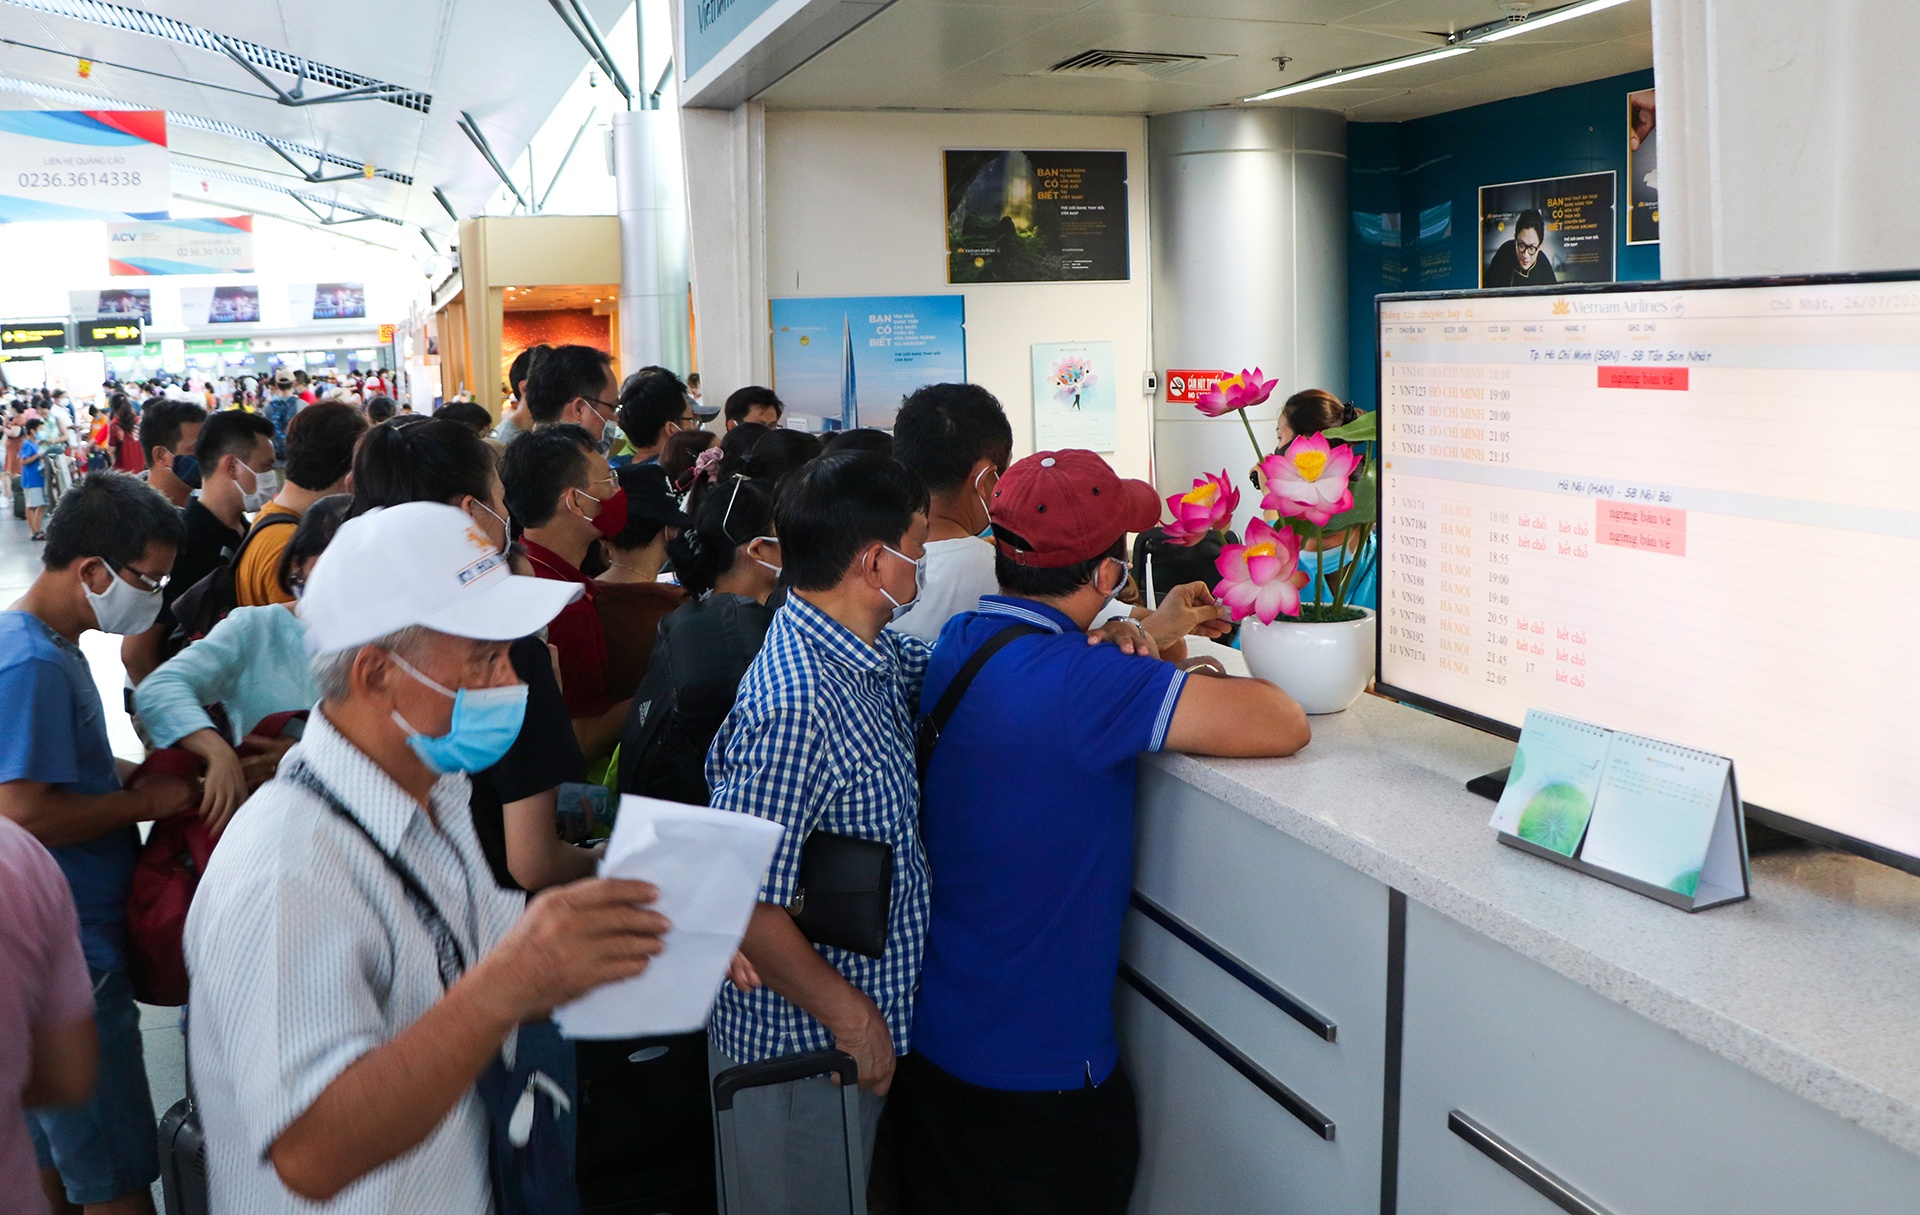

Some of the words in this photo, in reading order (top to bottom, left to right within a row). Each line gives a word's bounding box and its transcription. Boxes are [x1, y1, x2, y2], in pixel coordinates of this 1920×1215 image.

[18, 171, 142, 188] 0236.3614338
[1037, 168, 1058, 178] BẠN
[1044, 178, 1058, 188] CÓ
[1037, 189, 1059, 199] BIẾT
[1547, 198, 1564, 208] BẠN
[1552, 208, 1563, 218] CÓ
[112, 233, 137, 242] ACV
[176, 247, 242, 256] 0236.3614338
[1572, 300, 1620, 314] Vietnam
[1622, 299, 1667, 313] Airlines
[1844, 294, 1920, 309] 26/07/202
[869, 315, 892, 325] BẠN
[1448, 309, 1460, 319] bay
[876, 324, 892, 334] CÓ
[869, 335, 892, 346] BIẾT
[1530, 350, 1541, 361] Tp.
[1558, 349, 1571, 360] Chí
[1573, 350, 1591, 360] Minh
[1594, 349, 1620, 362] (SGN)
[1631, 350, 1644, 361] SB
[1648, 350, 1663, 361] Tân
[1392, 385, 1395, 395] 2
[1400, 386, 1426, 396] VN7123
[1460, 388, 1484, 400] MINH
[1490, 389, 1510, 400] 19:00
[1392, 404, 1395, 414] 3
[1402, 404, 1425, 416] VN105
[1460, 407, 1484, 420] MINH
[1490, 410, 1510, 421] 20:00
[1392, 424, 1396, 432] 4
[1402, 424, 1425, 435] VN143
[1460, 427, 1484, 440] MINH
[1490, 430, 1510, 442] 21:05
[1392, 442, 1396, 451] 5
[1402, 442, 1425, 454] VN145
[1460, 448, 1484, 461] MINH
[1490, 451, 1510, 463] 21:15
[1392, 478, 1396, 488] 2
[1588, 483, 1614, 498] (HAN)
[1625, 488, 1637, 498] SB
[1392, 497, 1396, 506] 3
[1640, 533, 1657, 547] bán
[1640, 510, 1657, 524] bán
[1392, 516, 1396, 525] 4
[1400, 516, 1426, 530] VN7184
[1489, 532, 1509, 544] 18:45
[1392, 534, 1396, 543] 5
[1400, 535, 1427, 549] VN7178
[1489, 552, 1509, 565] 18:55
[1392, 552, 1396, 562] 6
[1400, 554, 1427, 568] VN7188
[1489, 572, 1509, 585] 19:00
[1392, 571, 1395, 580] 7
[1402, 572, 1425, 587] VN188
[1488, 592, 1509, 606] 19:40
[1392, 589, 1395, 598] 8
[1402, 591, 1425, 605] VN190
[1488, 611, 1508, 625] 20:55
[1391, 607, 1395, 616] 9
[1400, 609, 1426, 624] VN7198
[1487, 632, 1508, 646] 21:40
[1390, 625, 1397, 636] 10
[1402, 628, 1424, 643] VN192
[1487, 651, 1507, 666] 21:45
[1526, 662, 1535, 673] 17
[1390, 643, 1396, 653] 11
[1400, 646, 1425, 661] VN7174
[1486, 671, 1507, 686] 22:05
